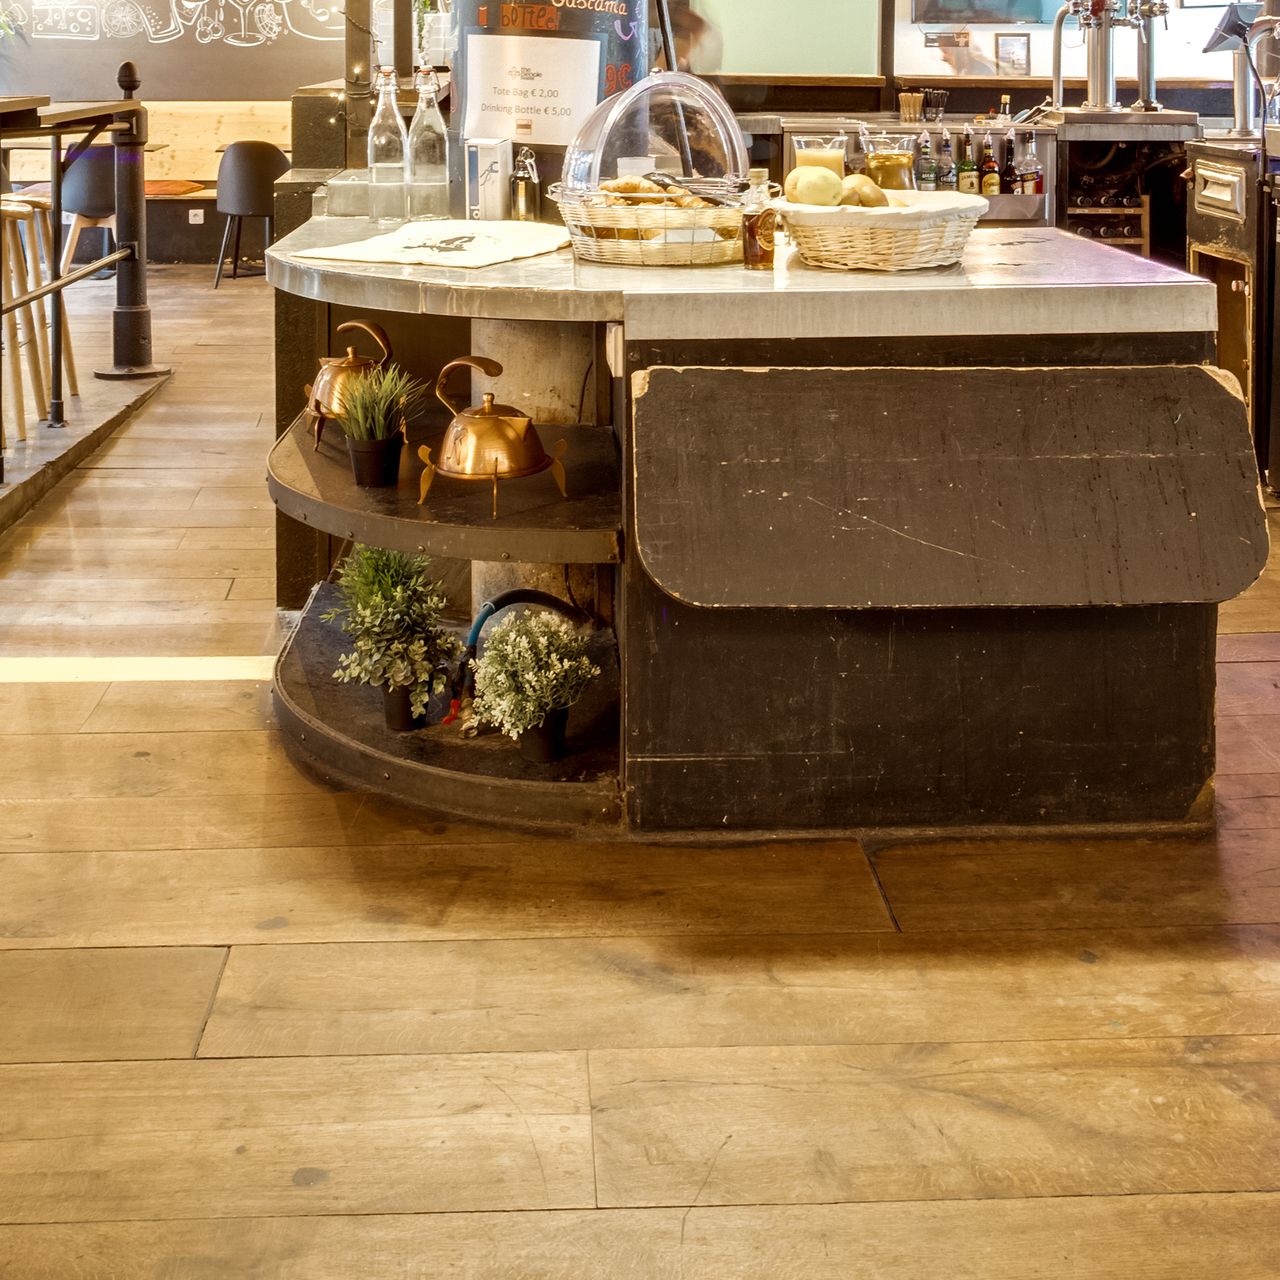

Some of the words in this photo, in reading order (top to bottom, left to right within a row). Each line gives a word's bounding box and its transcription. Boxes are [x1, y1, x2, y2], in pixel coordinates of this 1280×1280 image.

[493, 87, 511, 96] Tote
[513, 87, 529, 99] Bag
[530, 88, 537, 97] €
[539, 89, 559, 99] 2,00
[481, 103, 513, 115] Drinking
[515, 105, 541, 115] Bottle
[544, 106, 550, 115] €
[551, 107, 572, 117] 5,00
